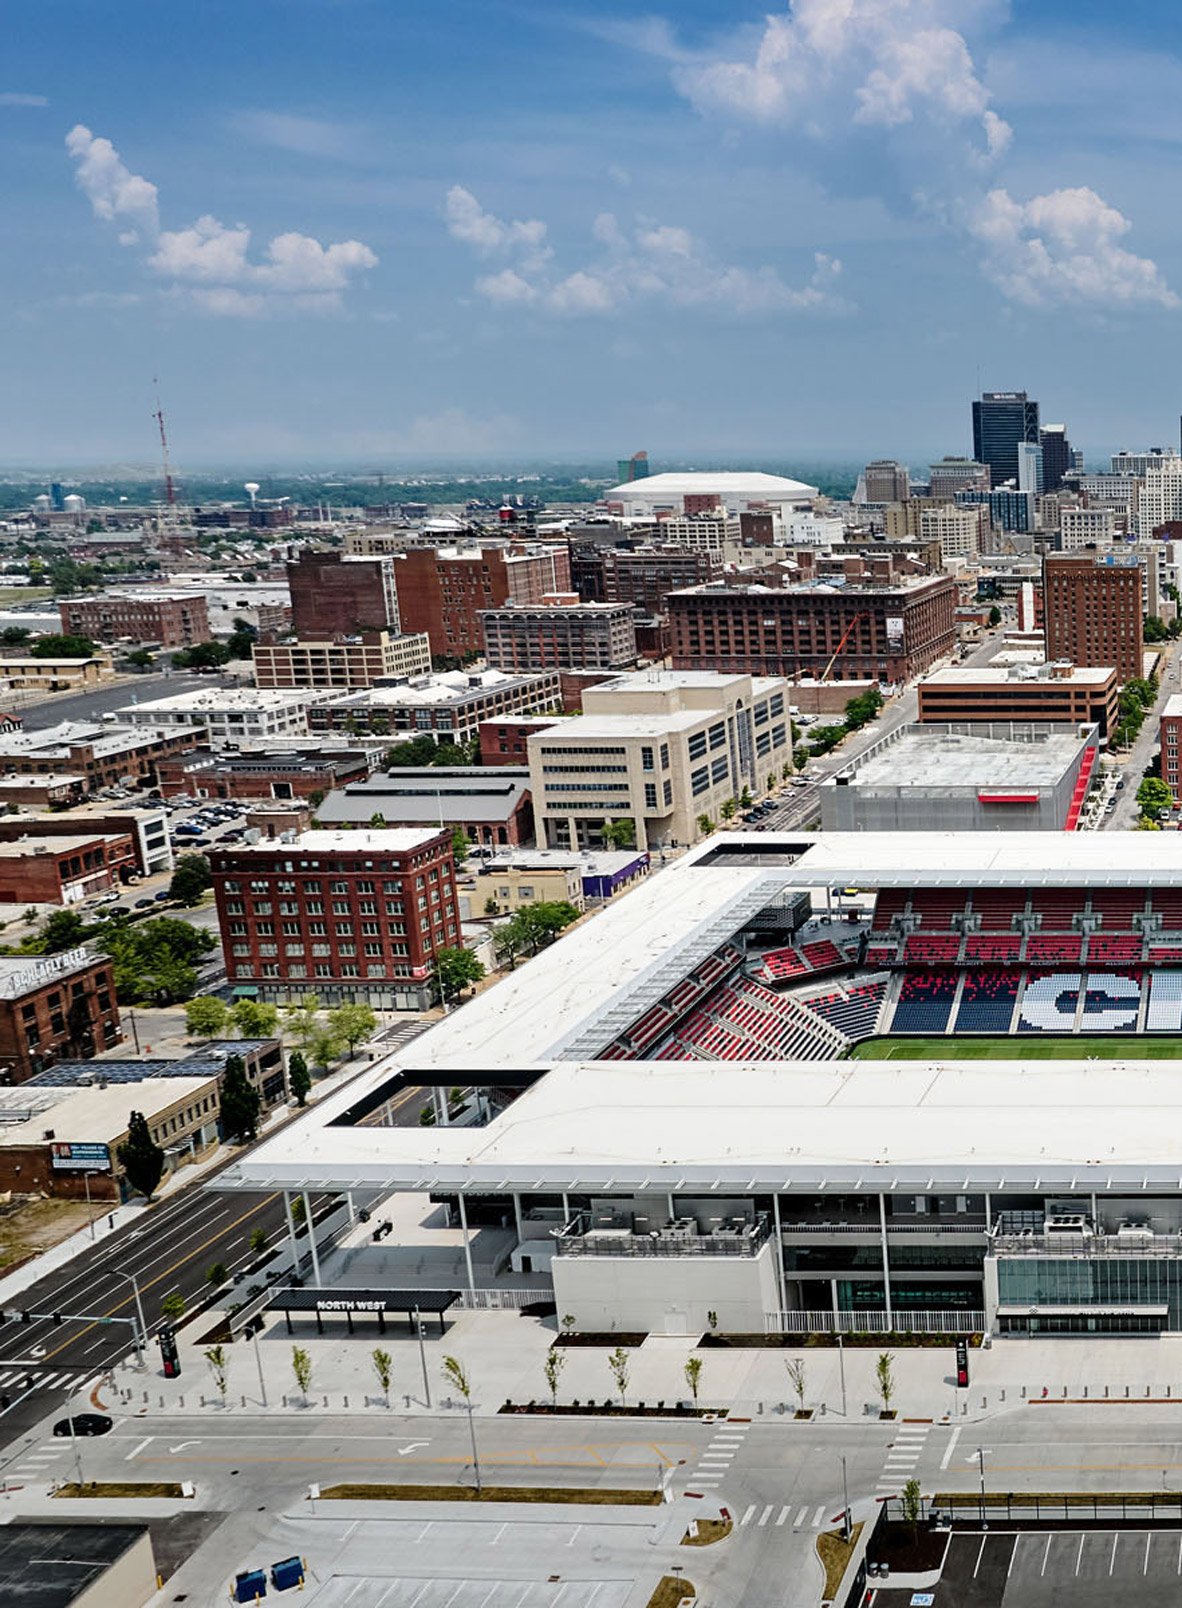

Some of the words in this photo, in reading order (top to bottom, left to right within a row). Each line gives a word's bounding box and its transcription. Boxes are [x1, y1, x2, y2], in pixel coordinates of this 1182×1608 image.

[13, 956, 62, 987] SCHLAFLY
[63, 947, 87, 967] BEER
[317, 1301, 354, 1311] NORTH
[355, 1301, 387, 1311] WEST
